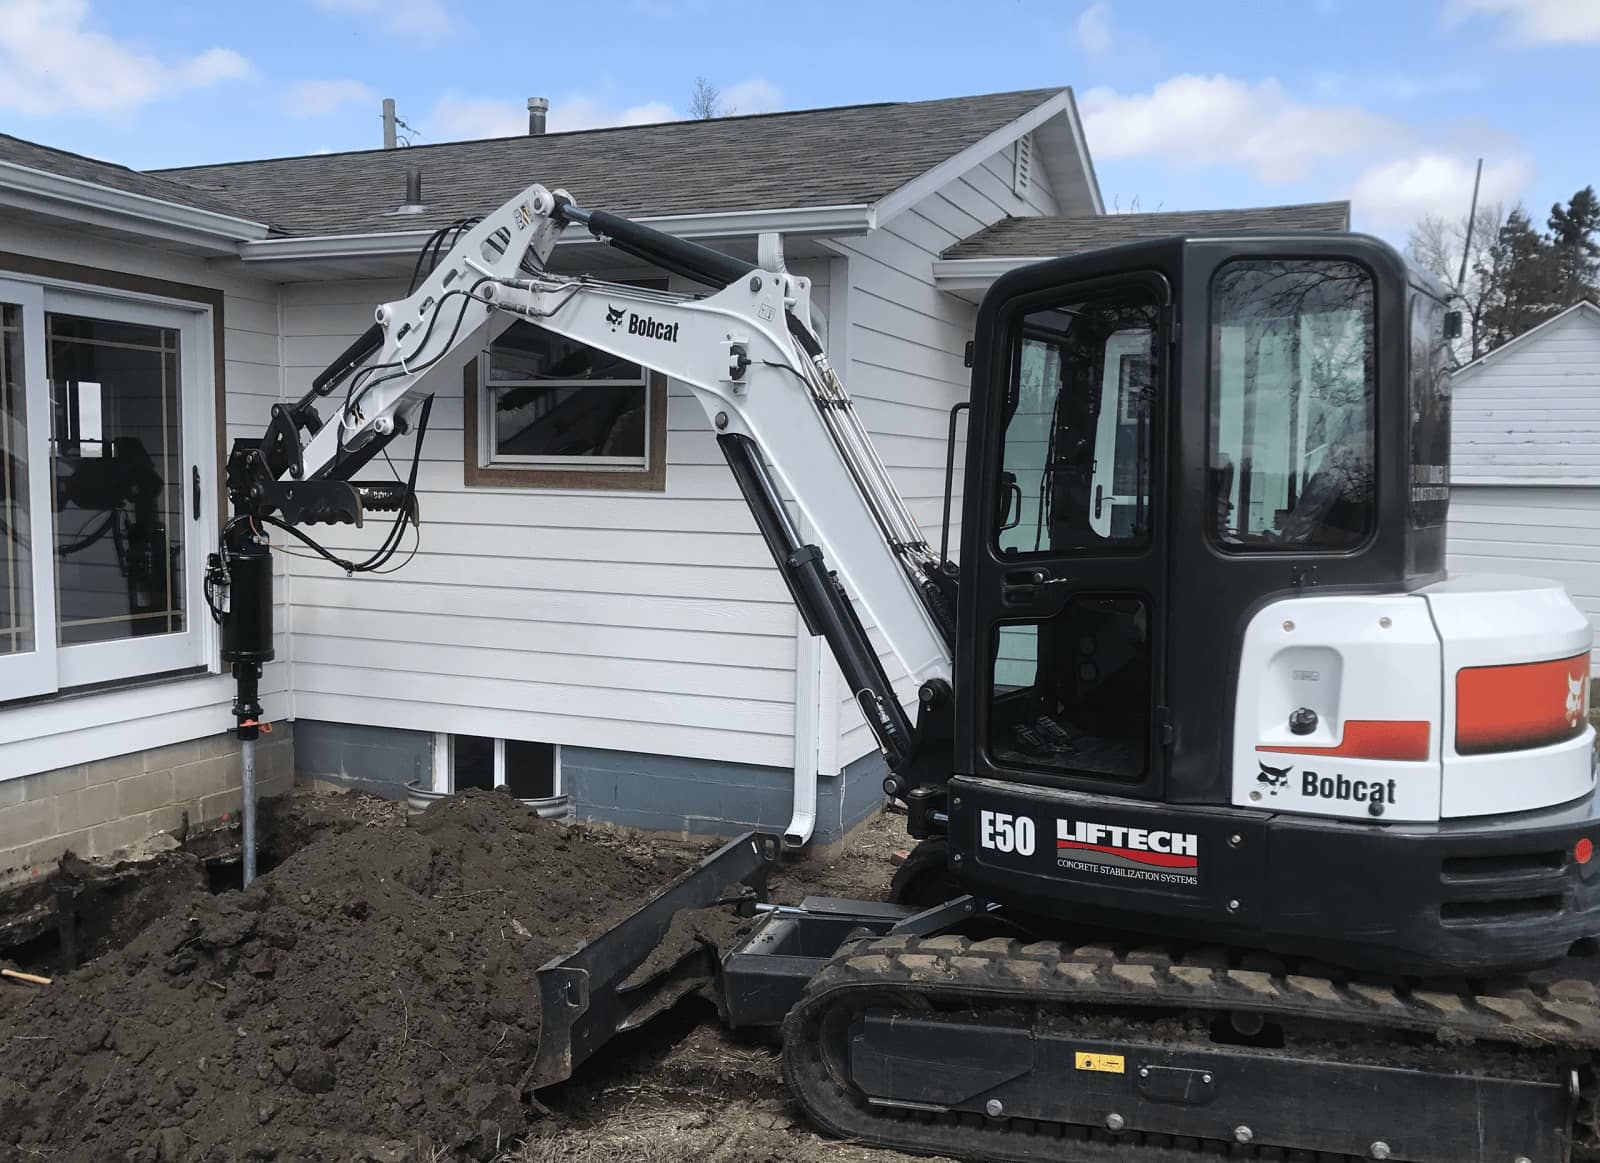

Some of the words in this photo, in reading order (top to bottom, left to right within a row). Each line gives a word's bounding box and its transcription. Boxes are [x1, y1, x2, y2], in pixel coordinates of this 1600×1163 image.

[628, 313, 679, 343] Bobcat
[1302, 771, 1396, 804] Bobcat
[980, 810, 1036, 857] E50
[1056, 818, 1198, 857] LIFTECH
[1057, 858, 1099, 873] CONCRETE
[1100, 865, 1160, 881] STABILIZATION
[1160, 873, 1198, 885] SYSTEMS
